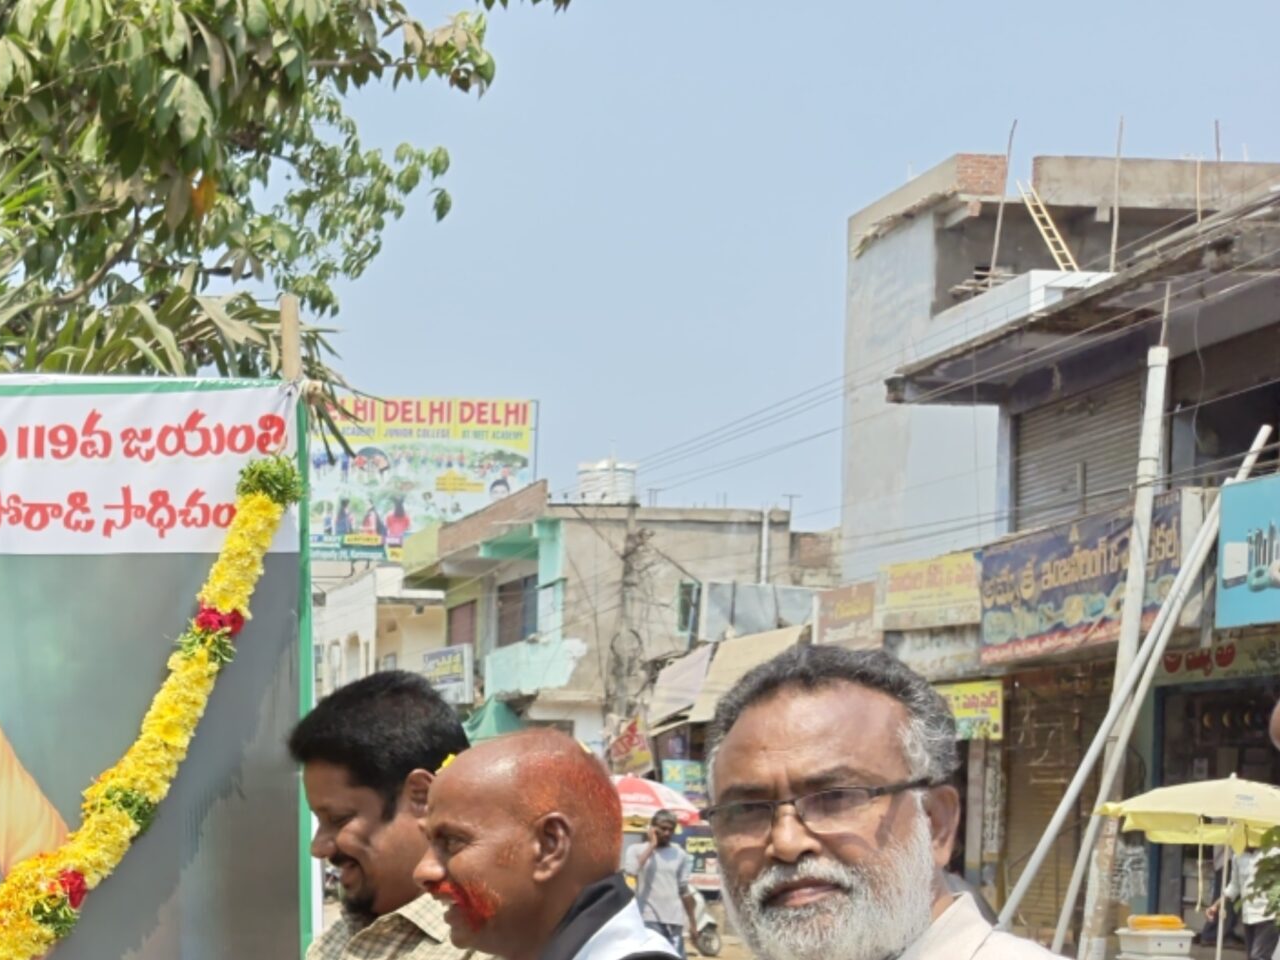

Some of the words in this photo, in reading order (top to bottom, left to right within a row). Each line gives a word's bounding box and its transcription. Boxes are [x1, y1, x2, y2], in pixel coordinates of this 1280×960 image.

[382, 399, 453, 425] DELHI
[459, 401, 528, 427] DELHI
[120, 410, 287, 463] జయంతి
